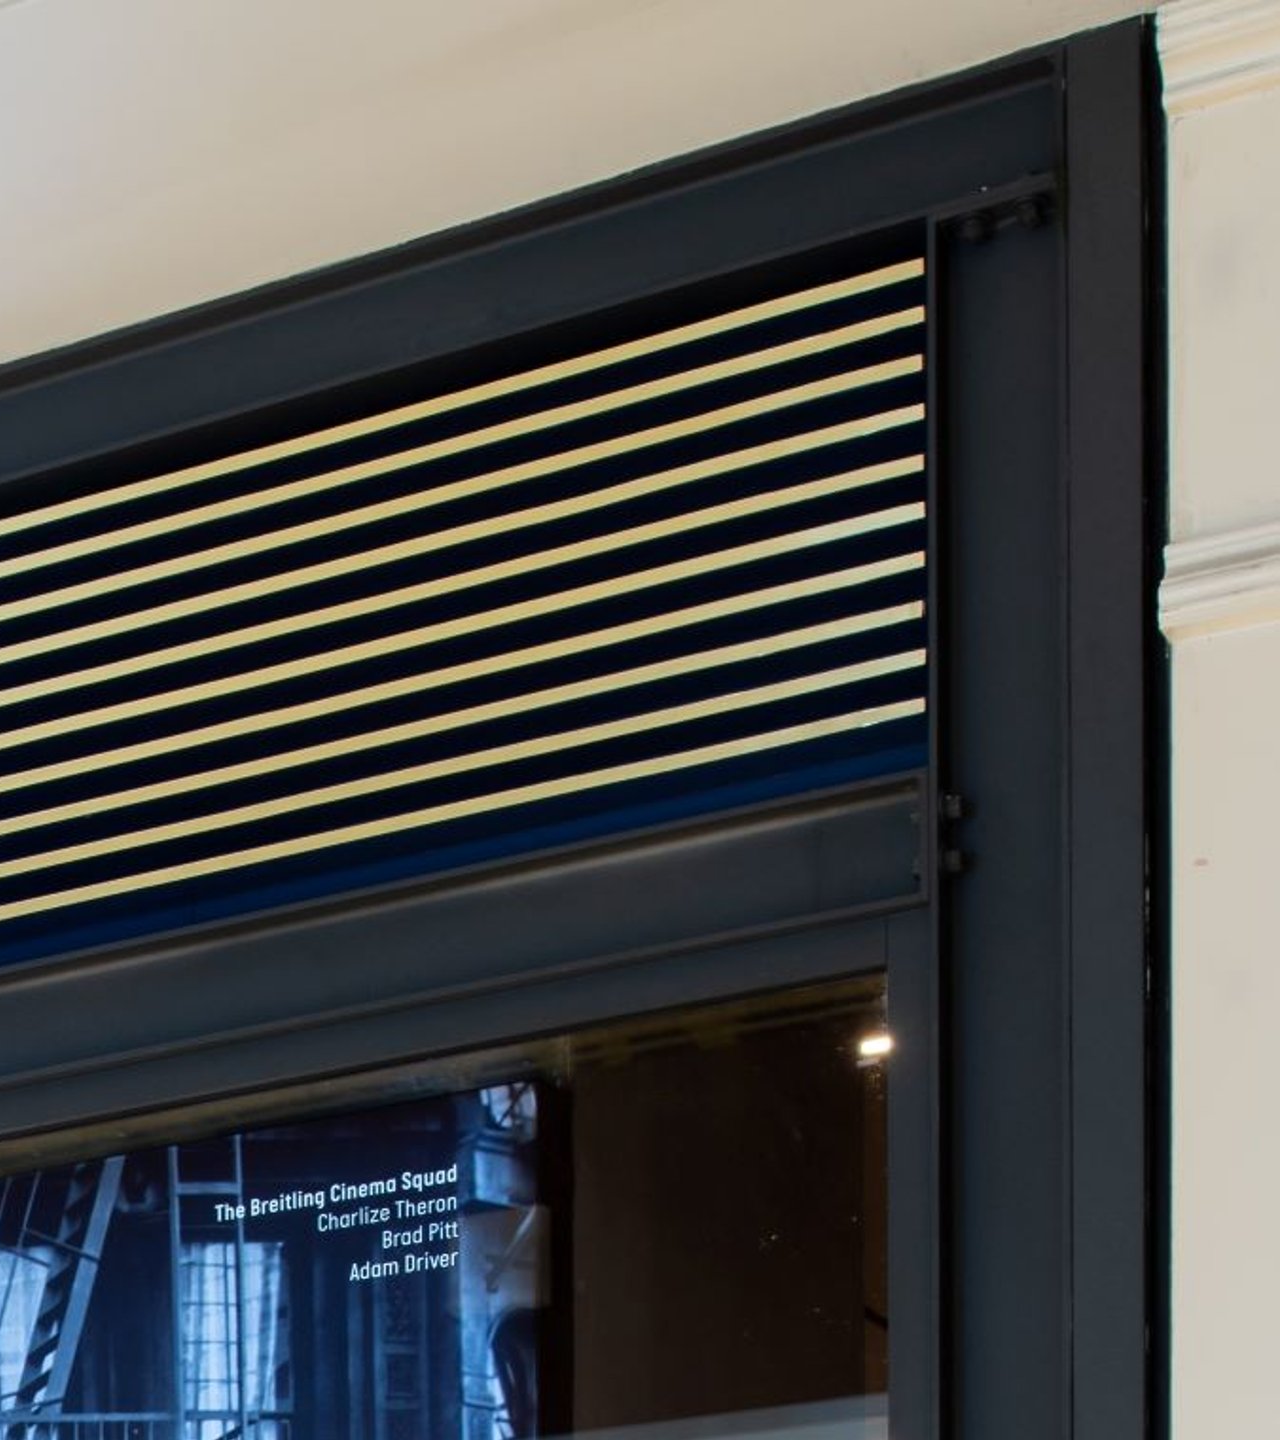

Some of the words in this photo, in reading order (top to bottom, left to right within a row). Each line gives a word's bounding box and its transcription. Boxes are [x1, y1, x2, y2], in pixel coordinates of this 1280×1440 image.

[214, 1203, 246, 1224] The
[250, 1186, 325, 1218] Breitling
[330, 1177, 397, 1204] Cinema
[401, 1163, 459, 1194] Squad
[317, 1204, 391, 1233] Charlize
[395, 1192, 458, 1220] Theron
[382, 1224, 424, 1250] Brad
[428, 1220, 459, 1243] Pitt
[349, 1258, 399, 1283] Adam
[404, 1250, 459, 1275] Driver
